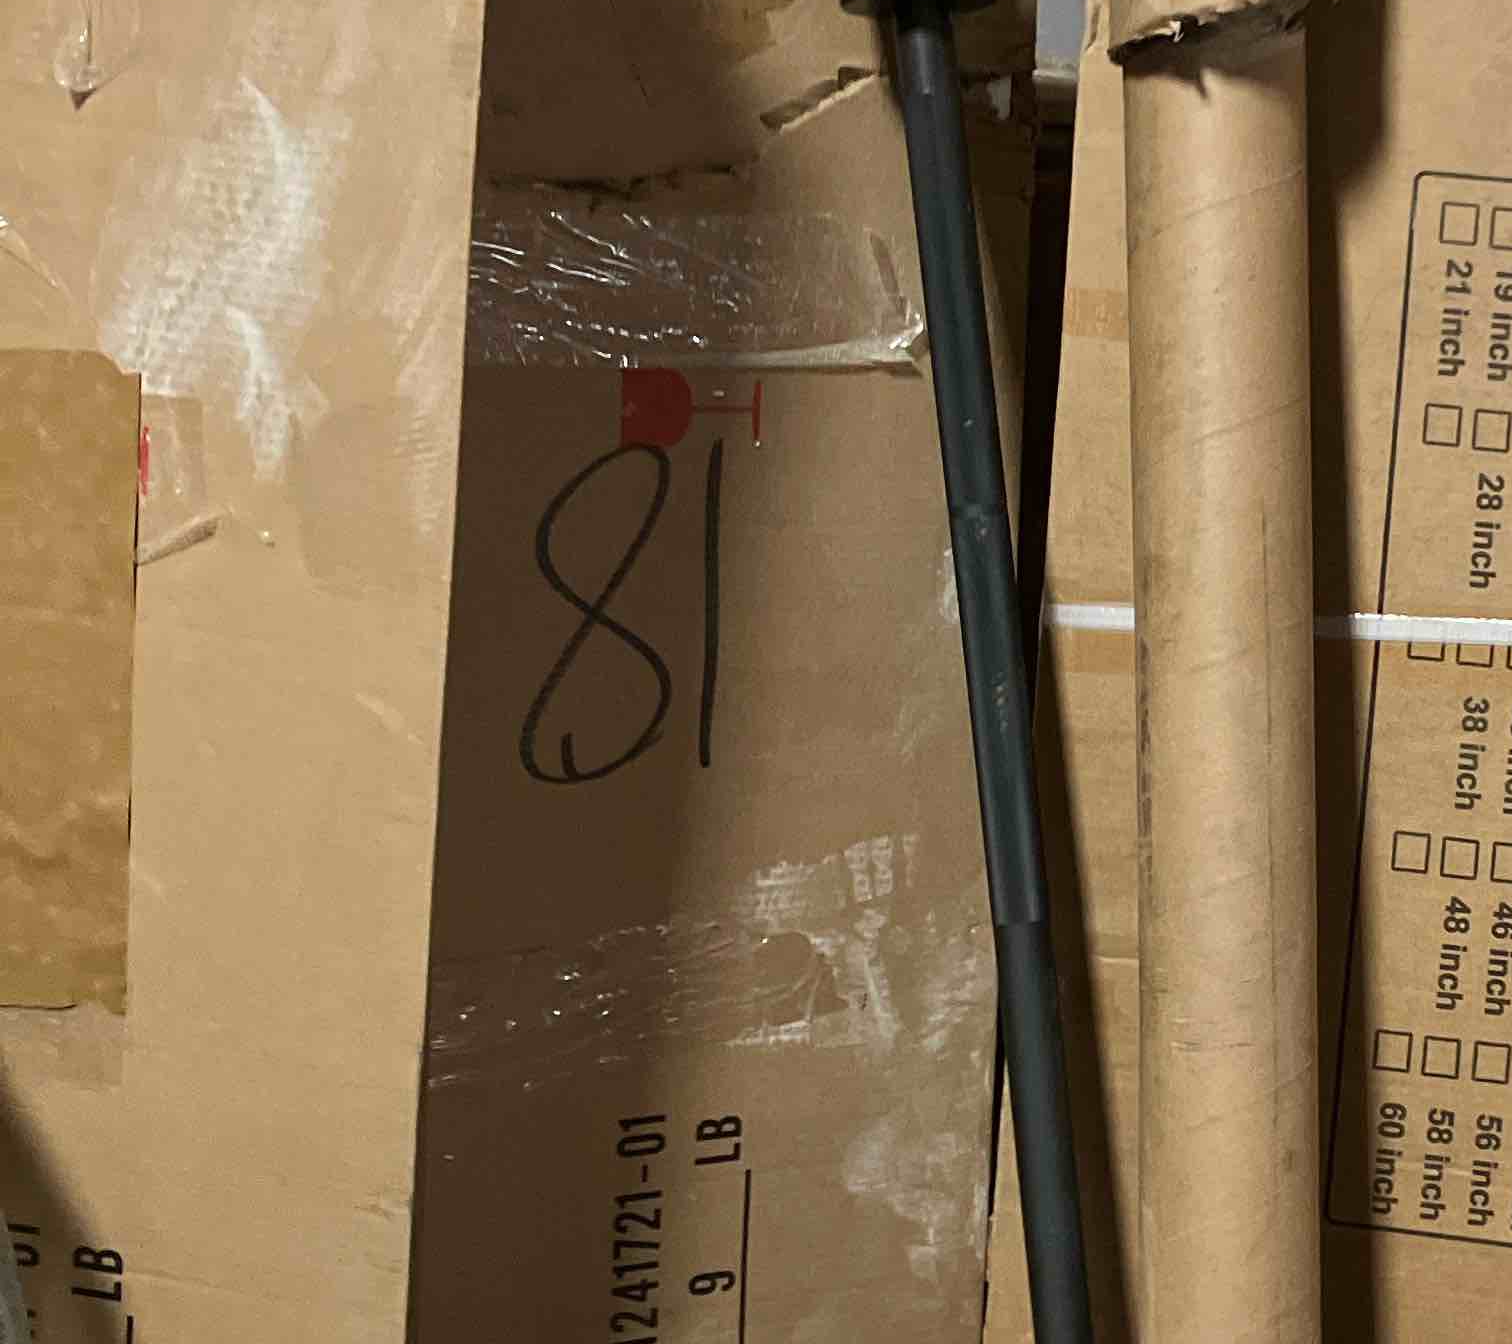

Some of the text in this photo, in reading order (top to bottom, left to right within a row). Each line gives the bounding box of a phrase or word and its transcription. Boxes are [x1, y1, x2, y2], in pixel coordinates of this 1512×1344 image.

[1438, 260, 1473, 376] 21 inch
[1469, 473, 1504, 588] 28 inch
[1455, 696, 1489, 809] 38 inch
[1436, 896, 1471, 1010] 48 inch
[688, 1114, 742, 1296] 9 LB
[1370, 1103, 1407, 1216] 60 inch
[1420, 1108, 1455, 1220] 58 inch
[1467, 1114, 1503, 1226] 56 inch
[70, 1245, 124, 1302] LB
